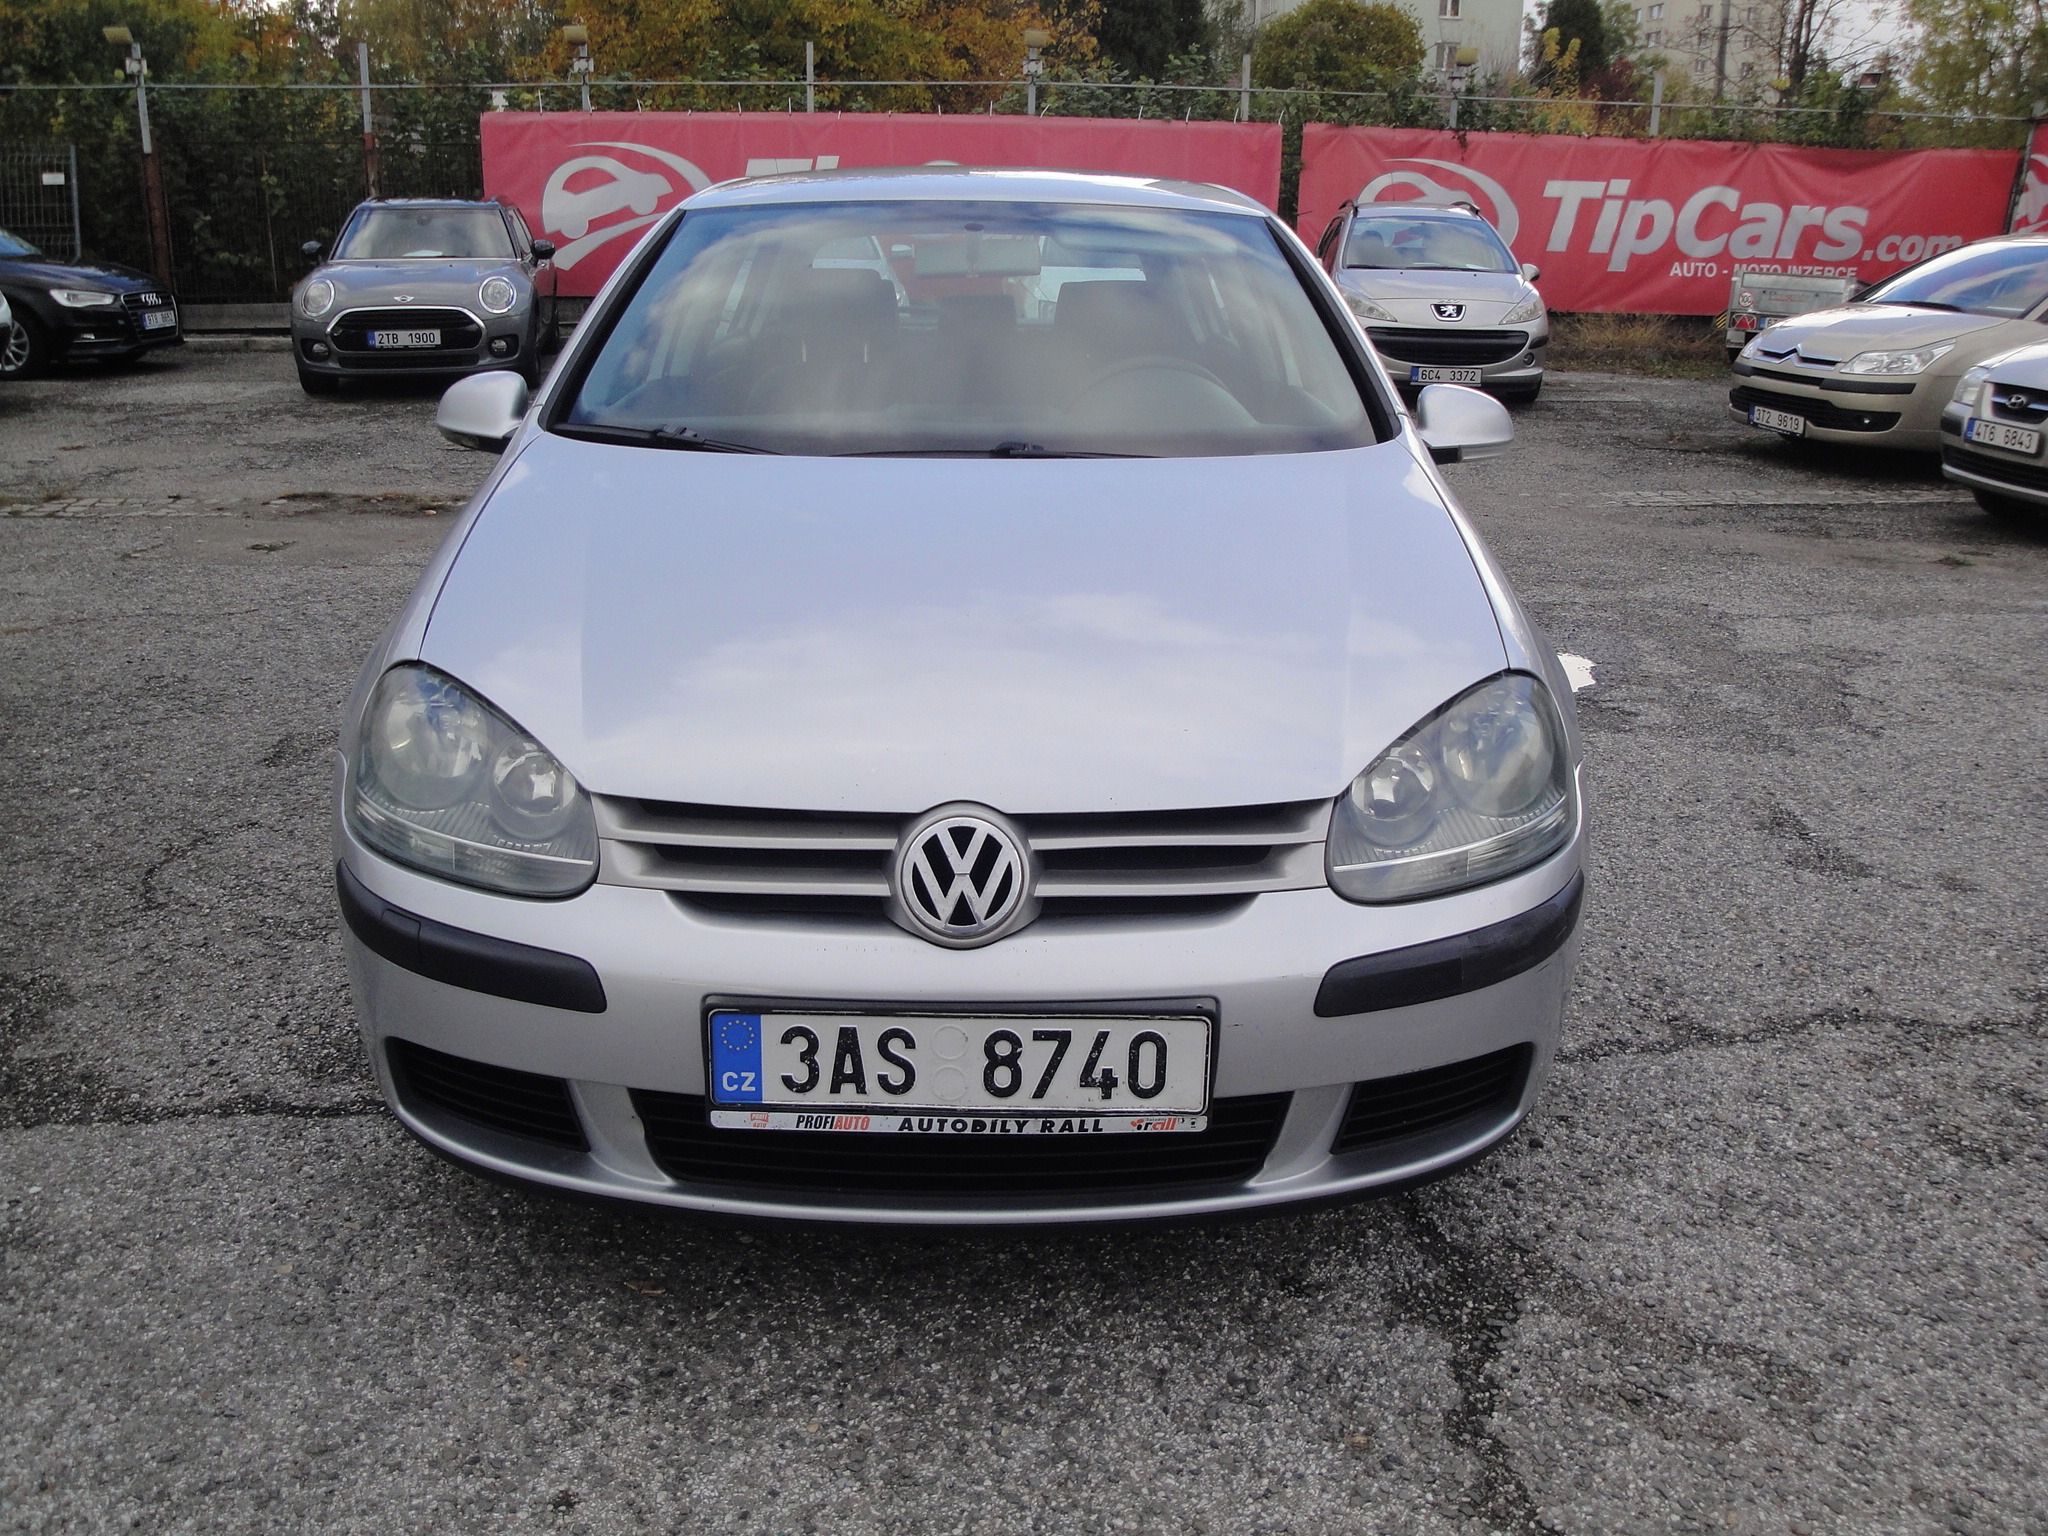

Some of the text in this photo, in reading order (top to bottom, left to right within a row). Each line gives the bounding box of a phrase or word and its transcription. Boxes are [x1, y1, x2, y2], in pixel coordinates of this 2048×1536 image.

[1670, 262, 1717, 277] AUTO
[378, 333, 399, 344] 2TB
[408, 332, 436, 344] 1900
[1421, 369, 1476, 381] 6C4 3372
[780, 1025, 1168, 1100] 3AS 8740
[722, 1071, 756, 1093] CZ
[795, 1114, 870, 1131] PROFIAUTO
[1040, 1118, 1104, 1133] RALL
